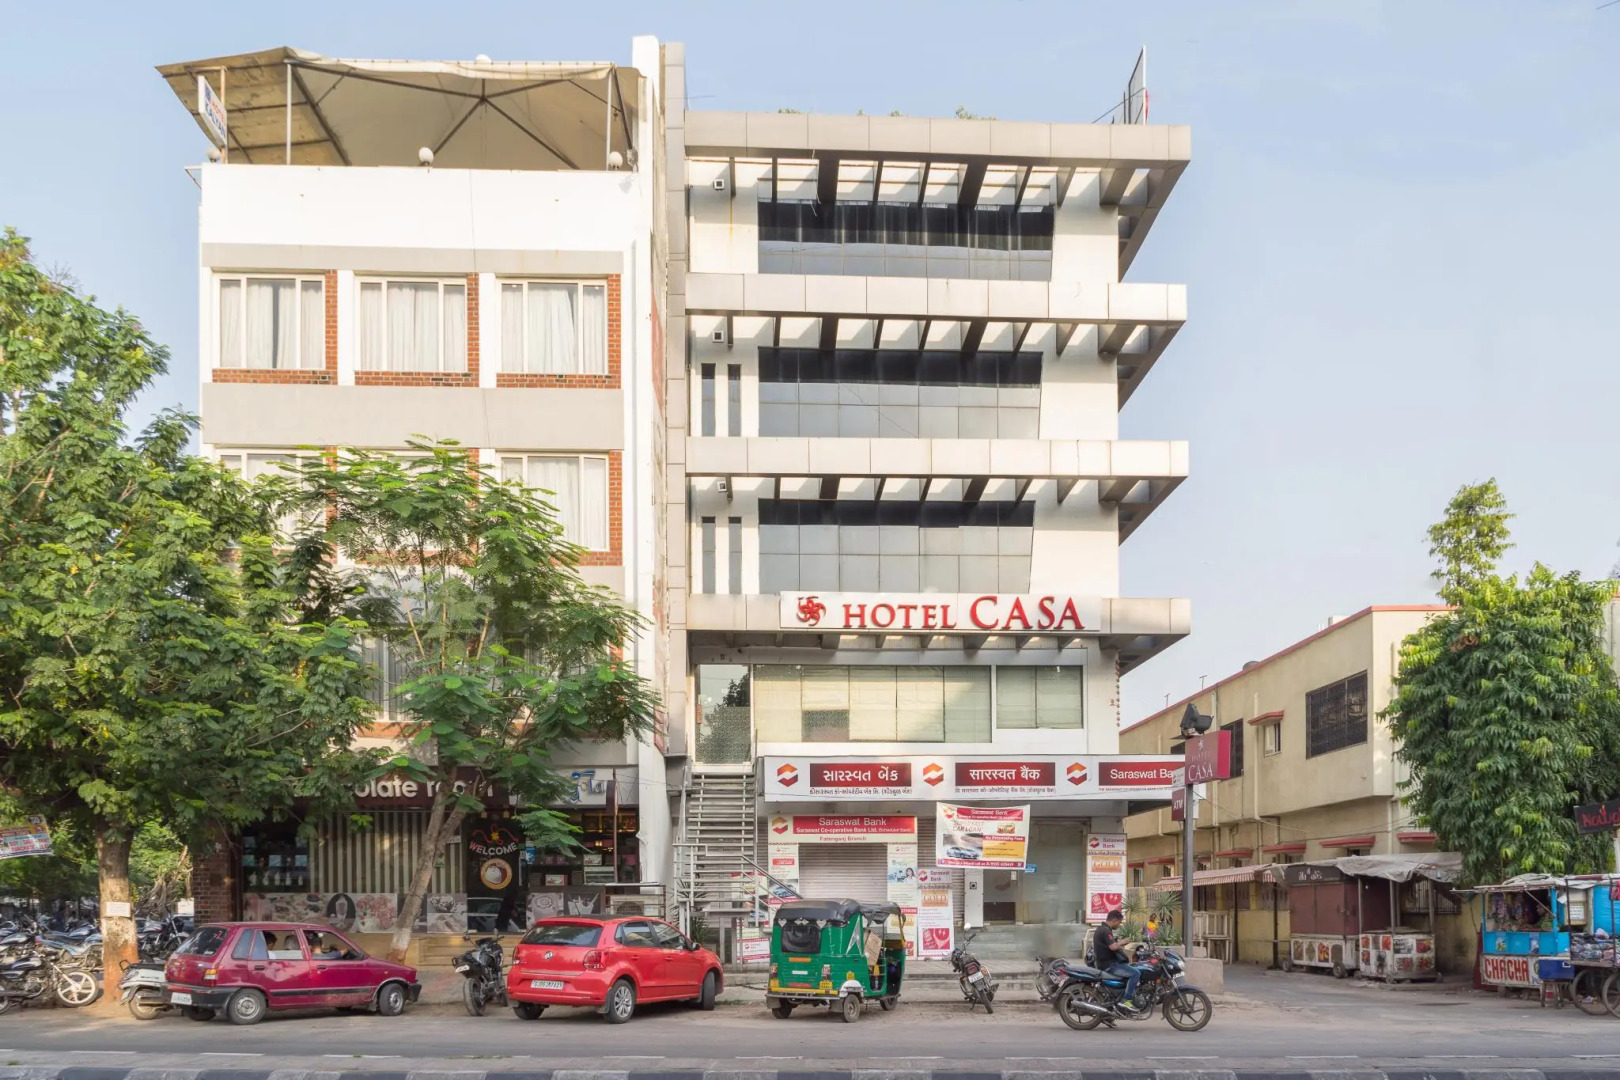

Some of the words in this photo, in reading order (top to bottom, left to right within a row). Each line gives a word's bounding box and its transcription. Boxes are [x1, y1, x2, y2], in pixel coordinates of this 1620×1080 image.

[842, 603, 957, 629] HOTEL
[969, 595, 1086, 630] CASA
[823, 769, 871, 782] સારસ્વત
[969, 768, 1017, 781] सारस्वत
[1020, 764, 1041, 780] बैंक
[1110, 768, 1157, 779] Saraswat
[1159, 769, 1173, 778] Ba
[1188, 762, 1213, 782] CASA
[350, 774, 418, 798] olate
[1173, 800, 1184, 811] ATM
[818, 817, 860, 826] Saraswat
[863, 817, 886, 826] Bank
[469, 841, 518, 856] WELCOME
